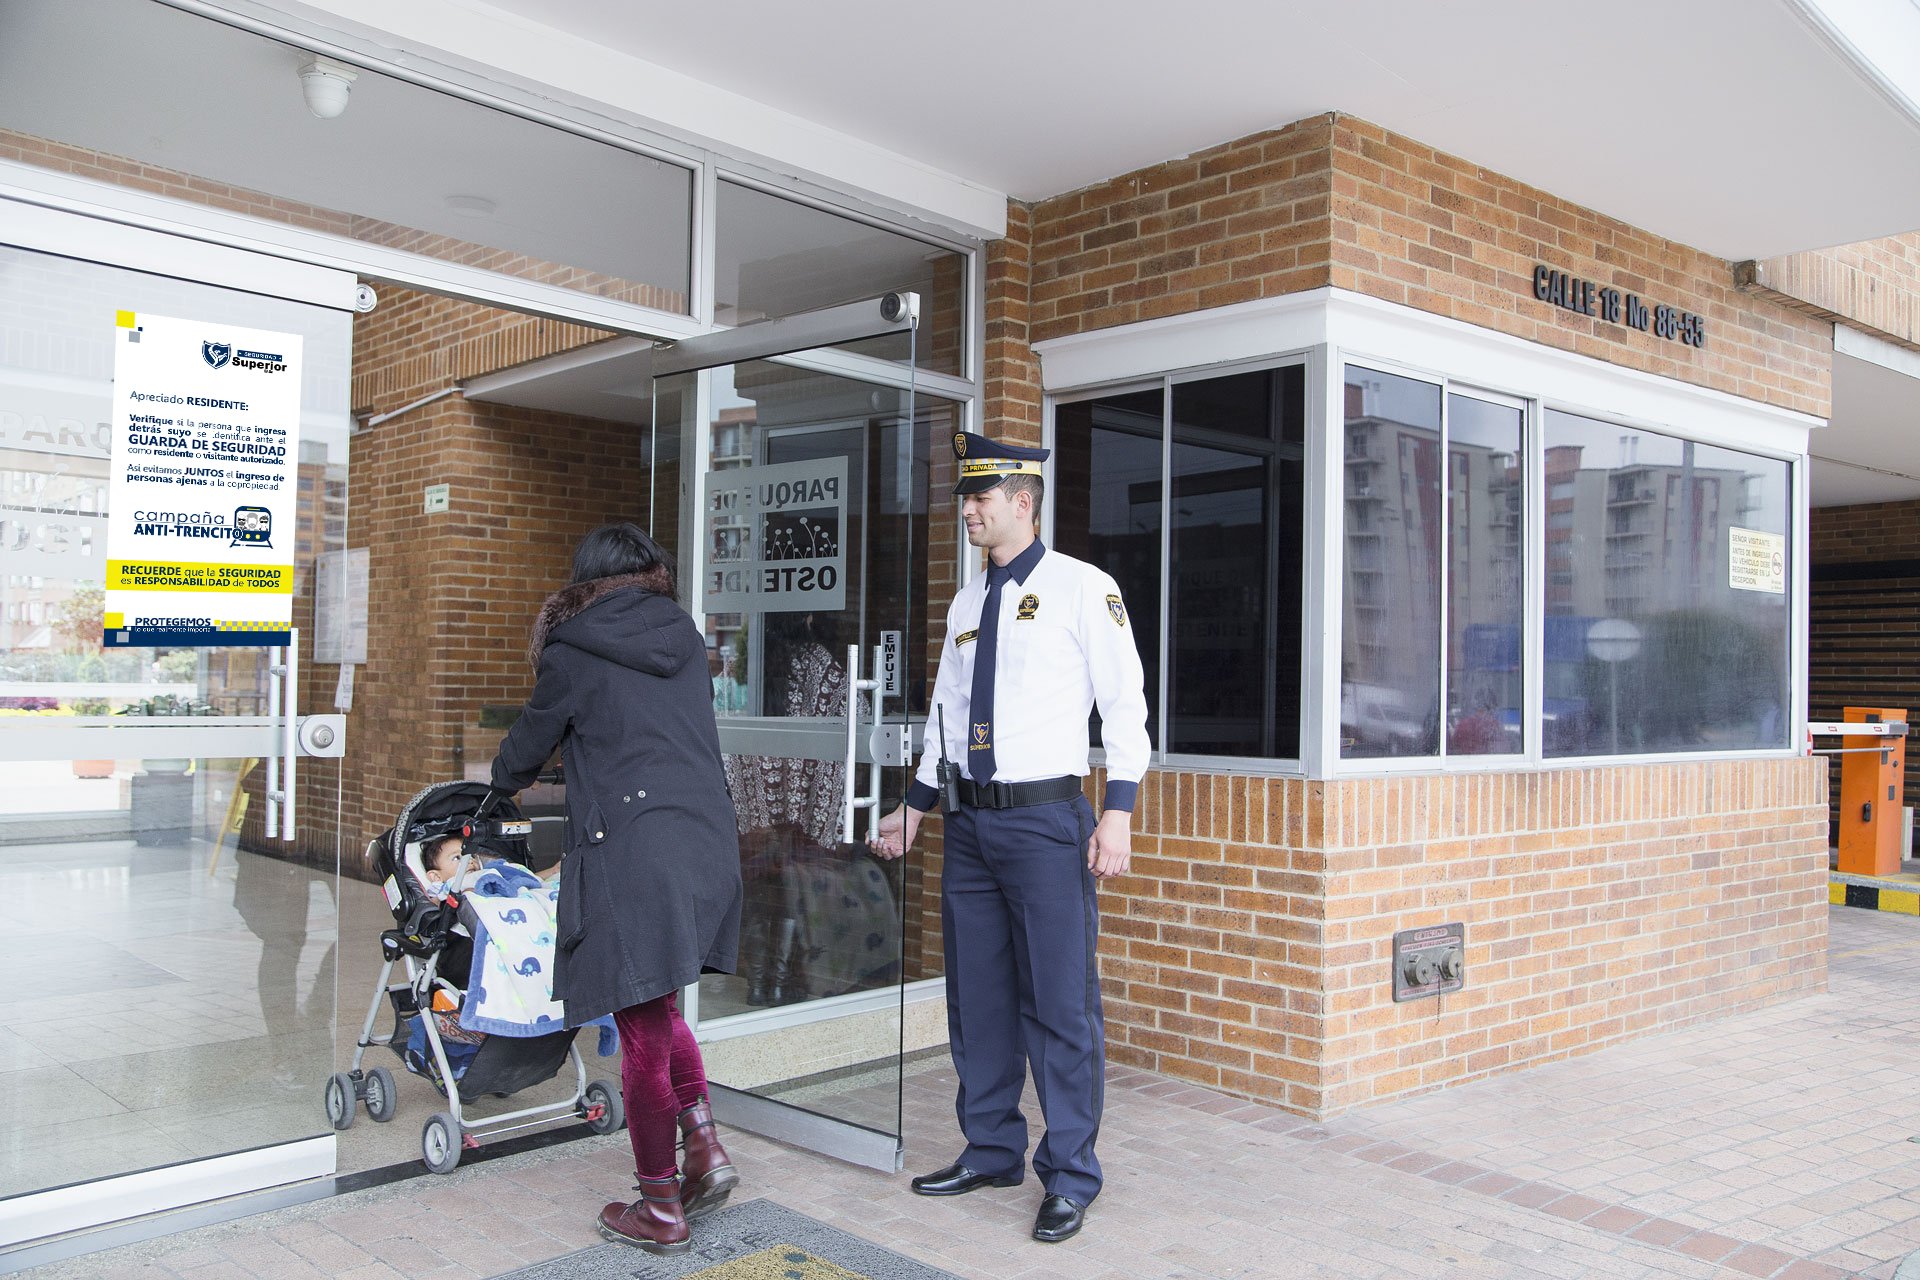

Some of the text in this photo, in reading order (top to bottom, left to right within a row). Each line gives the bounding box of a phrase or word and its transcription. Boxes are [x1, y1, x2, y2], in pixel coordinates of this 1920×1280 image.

[1534, 264, 1705, 348] CALLE 18 No 86-55
[232, 356, 288, 372] Superior
[130, 390, 249, 411] Apreciado RESIDENTE:
[129, 414, 173, 426] Verifique
[186, 419, 194, 427] la
[198, 422, 232, 432] persona
[236, 425, 252, 434] que
[254, 426, 286, 436] ingresa
[129, 423, 161, 434] detrás
[168, 428, 191, 438] suyo
[197, 430, 206, 438] se
[256, 436, 273, 444] ante
[278, 436, 286, 444] el
[128, 434, 286, 456] GUARDA DE SEGURIDAD
[128, 447, 151, 455] como
[154, 449, 193, 458] residente
[203, 452, 238, 462] visitante
[127, 473, 173, 484] personas
[176, 477, 207, 486] ajenas
[217, 479, 225, 487] la
[143, 465, 182, 475] evitamos
[184, 467, 224, 478] JUNTOS
[226, 471, 233, 479] el
[236, 471, 270, 483] ingreso
[272, 474, 285, 482] de
[134, 510, 225, 525] campaña
[133, 524, 244, 540] ANTI-TRENCITO
[122, 565, 281, 579] RECUERDE que la SEGURIDAD
[121, 576, 280, 588] es RESPONSABILIDAD de TODOS
[135, 618, 211, 626] PROTEGEMOS
[884, 634, 895, 691] EMPUJE
